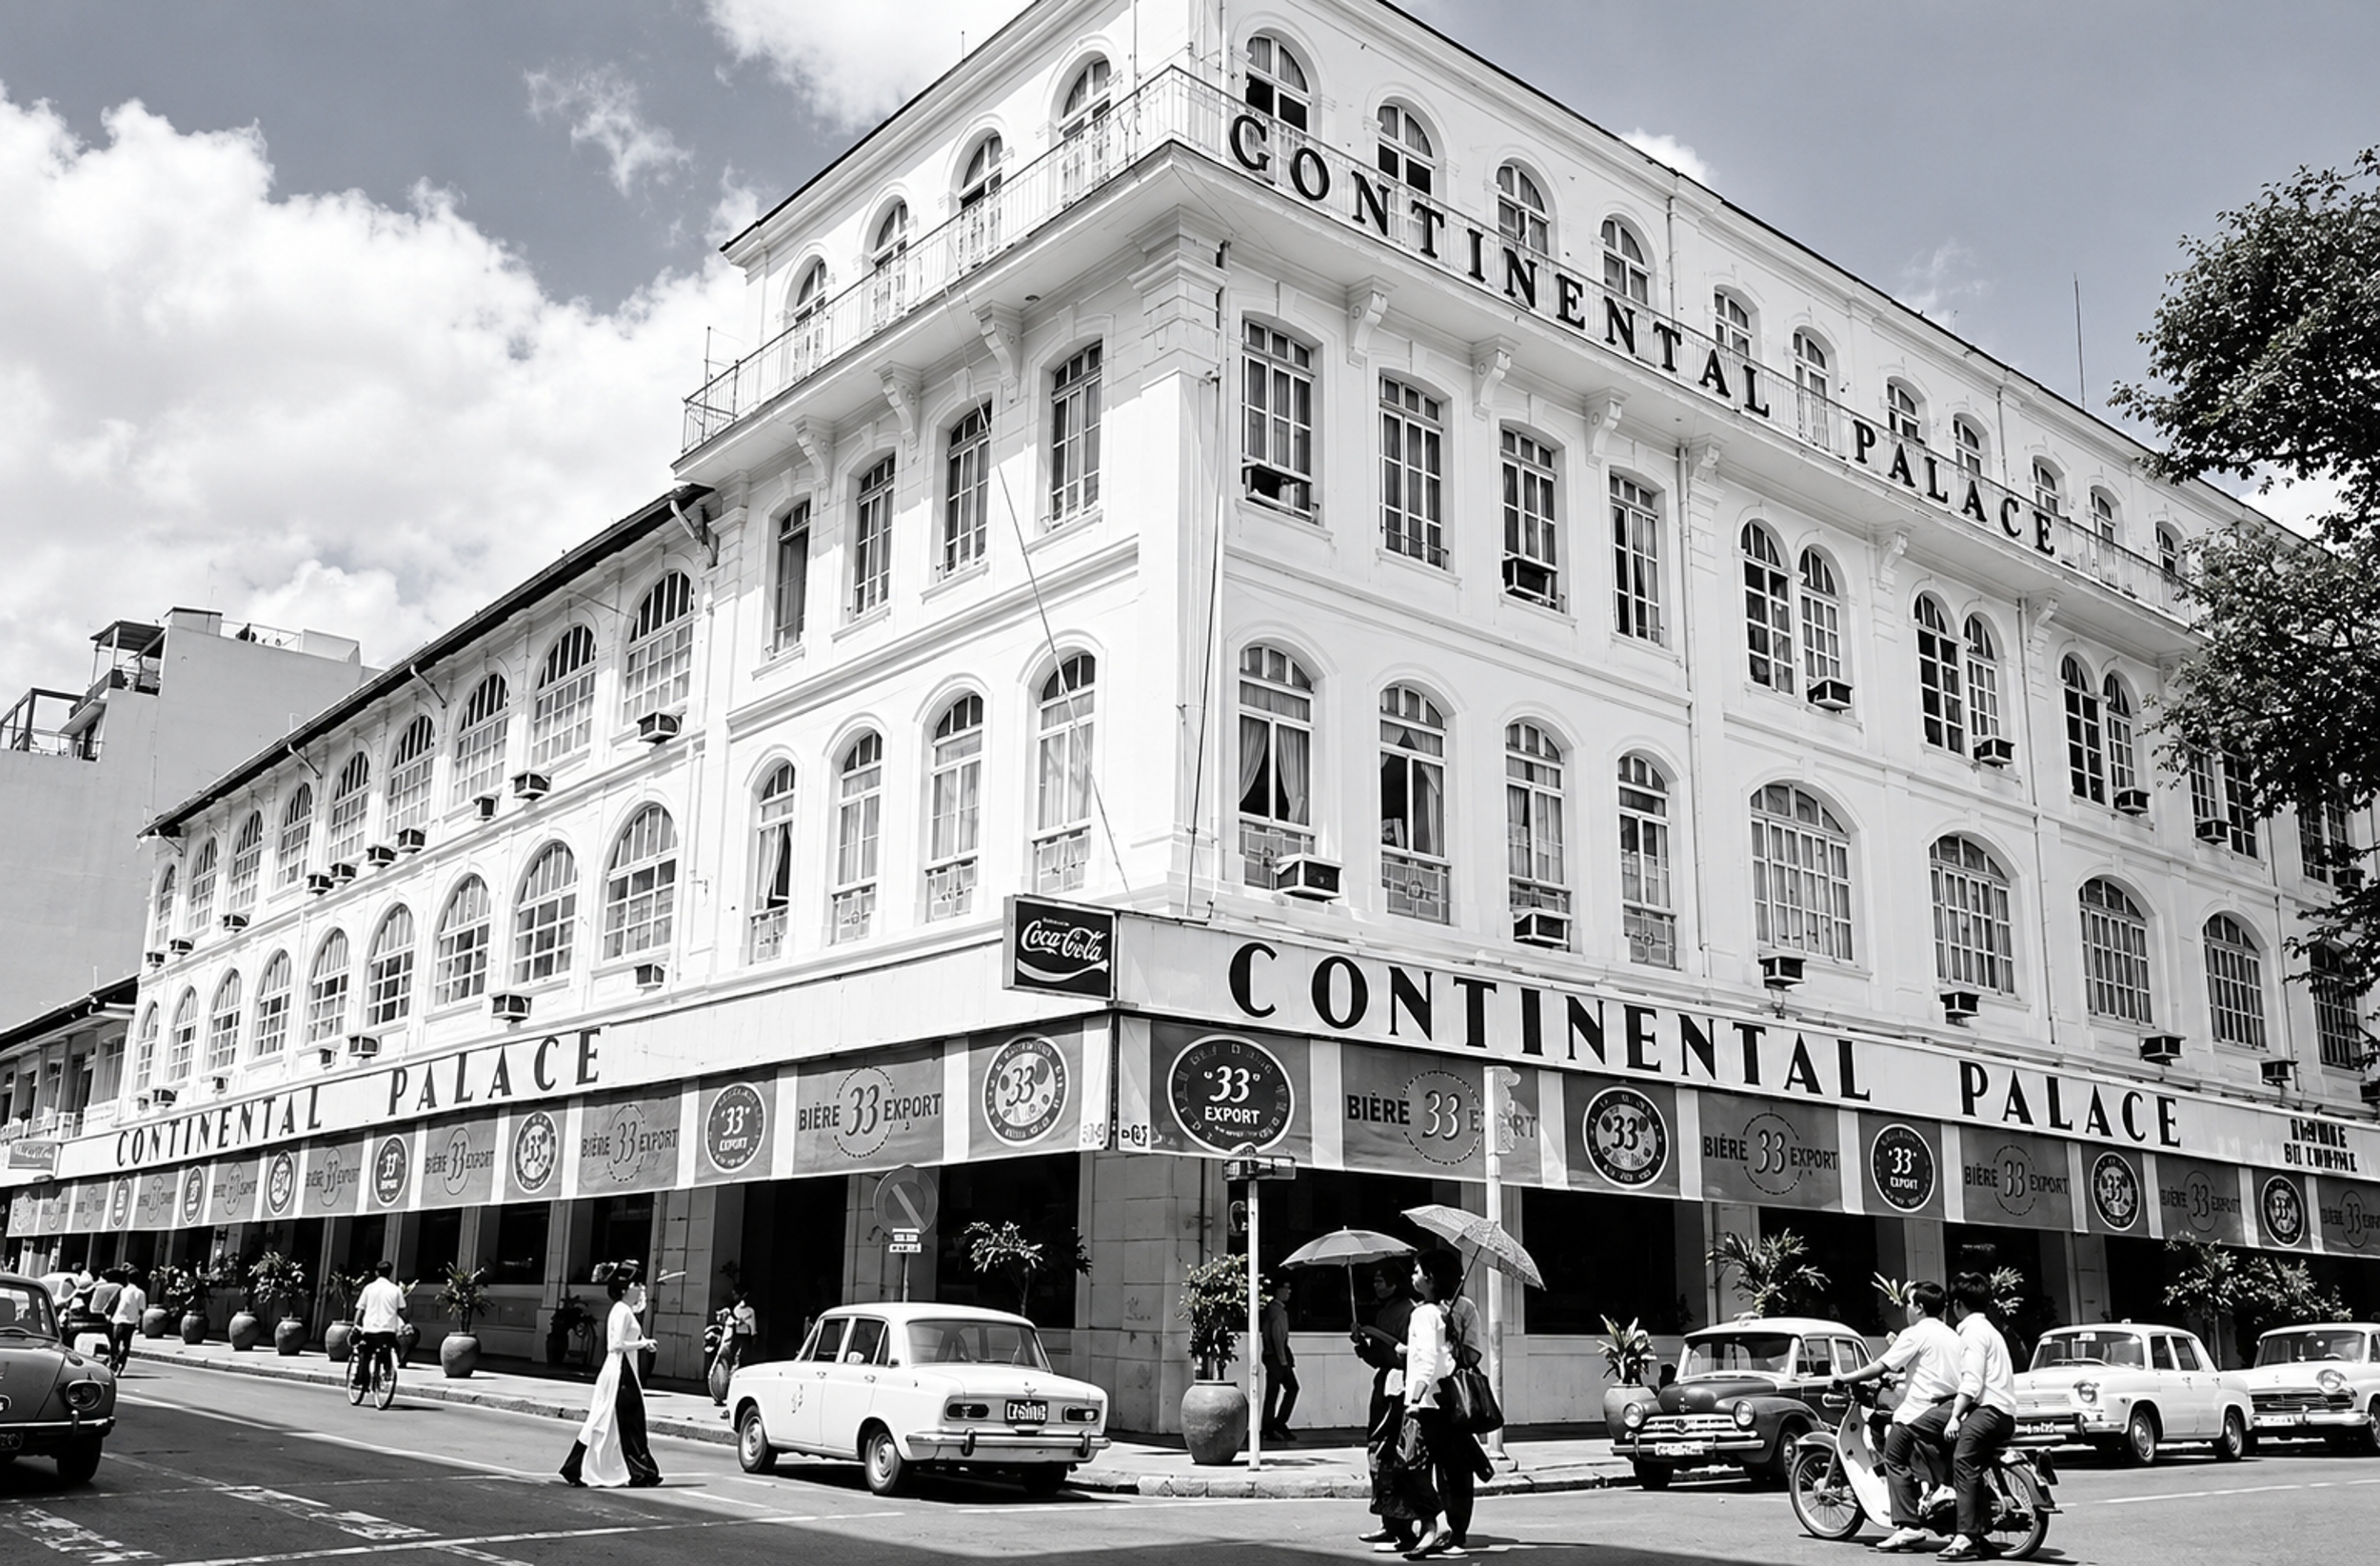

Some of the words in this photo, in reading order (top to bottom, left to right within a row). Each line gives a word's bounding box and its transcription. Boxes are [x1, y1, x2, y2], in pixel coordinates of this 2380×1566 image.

[1853, 419, 2055, 556] PALACE
[1021, 920, 1106, 961] Coca-Cola
[1229, 942, 1871, 1102] CONTINENTAL
[1959, 1060, 2181, 1148] PALACE
[116, 1085, 322, 1166] CONTINENTAL
[387, 1028, 601, 1116] PALACE
[1005, 1064, 1036, 1107] 33
[844, 1082, 881, 1138] 33
[883, 1092, 942, 1122] EXPORT
[1204, 1105, 1260, 1125] EXPORT
[1421, 1089, 1461, 1141] 33
[613, 1120, 638, 1165] 33
[1610, 1115, 1640, 1151] 33
[1754, 1129, 1787, 1175] 33
[1790, 1146, 1838, 1171] EXPORT
[2003, 1160, 2026, 1199] 33
